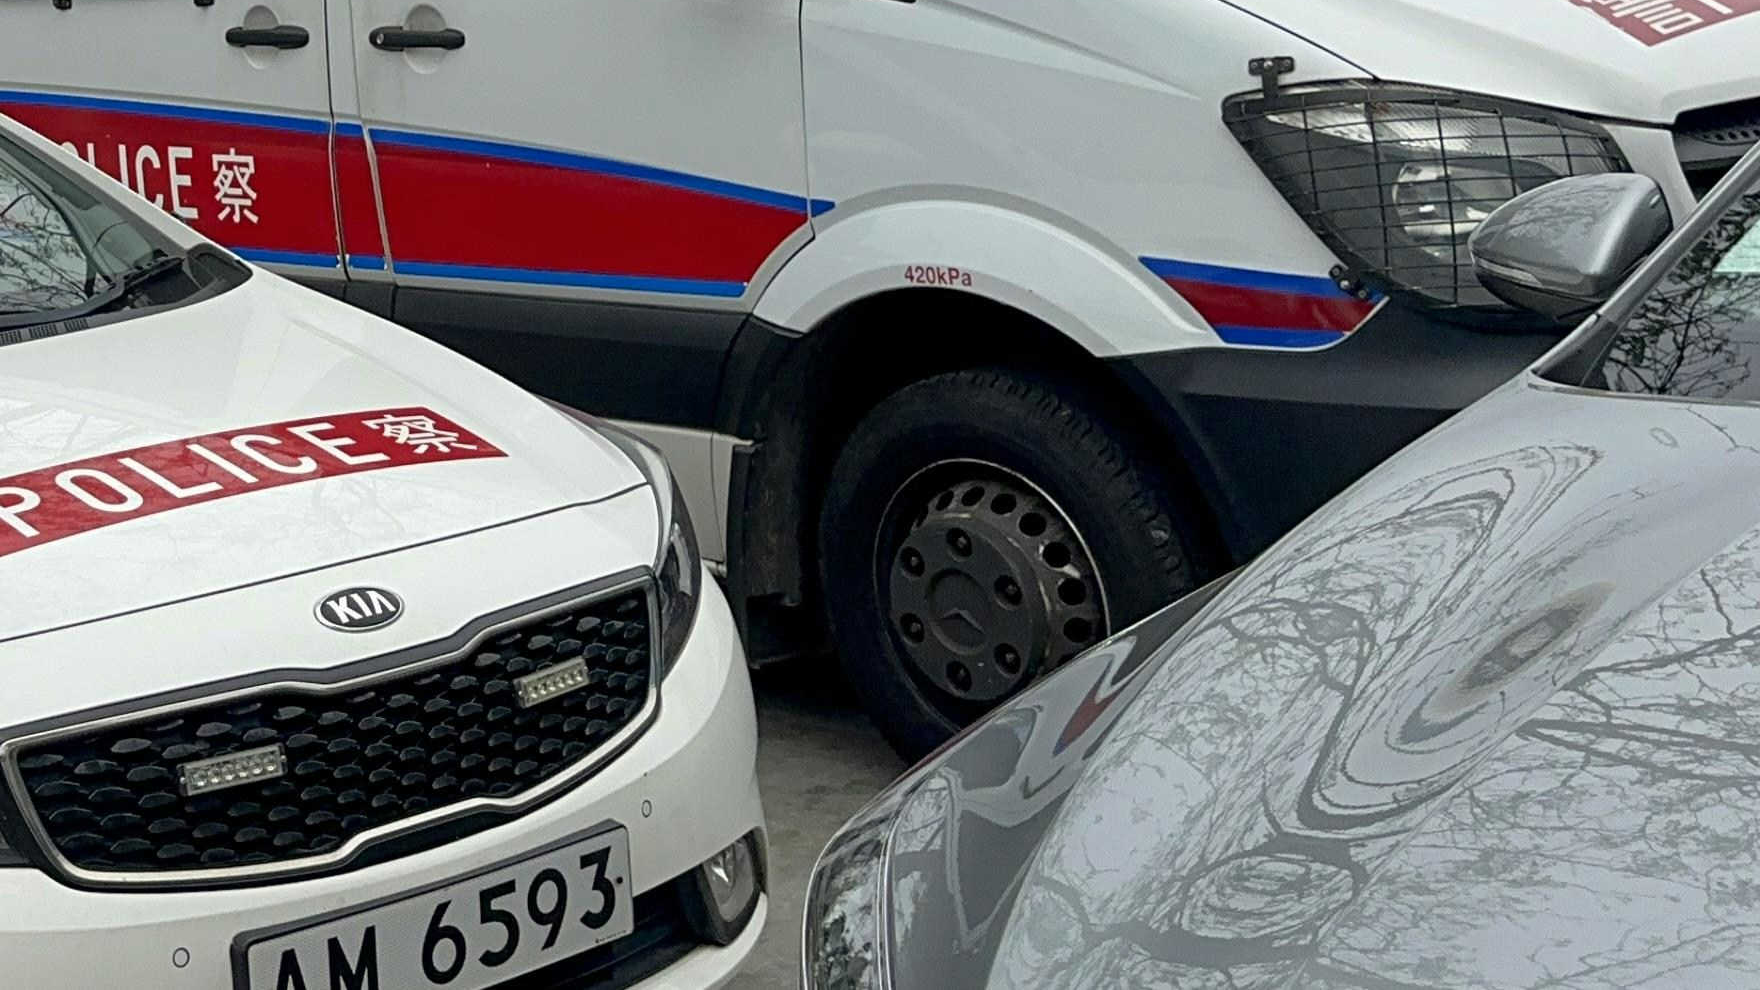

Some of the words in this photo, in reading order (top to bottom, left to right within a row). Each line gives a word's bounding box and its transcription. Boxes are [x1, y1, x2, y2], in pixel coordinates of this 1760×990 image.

[905, 265, 972, 287] 420kPa
[325, 590, 397, 624] KIA
[422, 844, 617, 986] 6593
